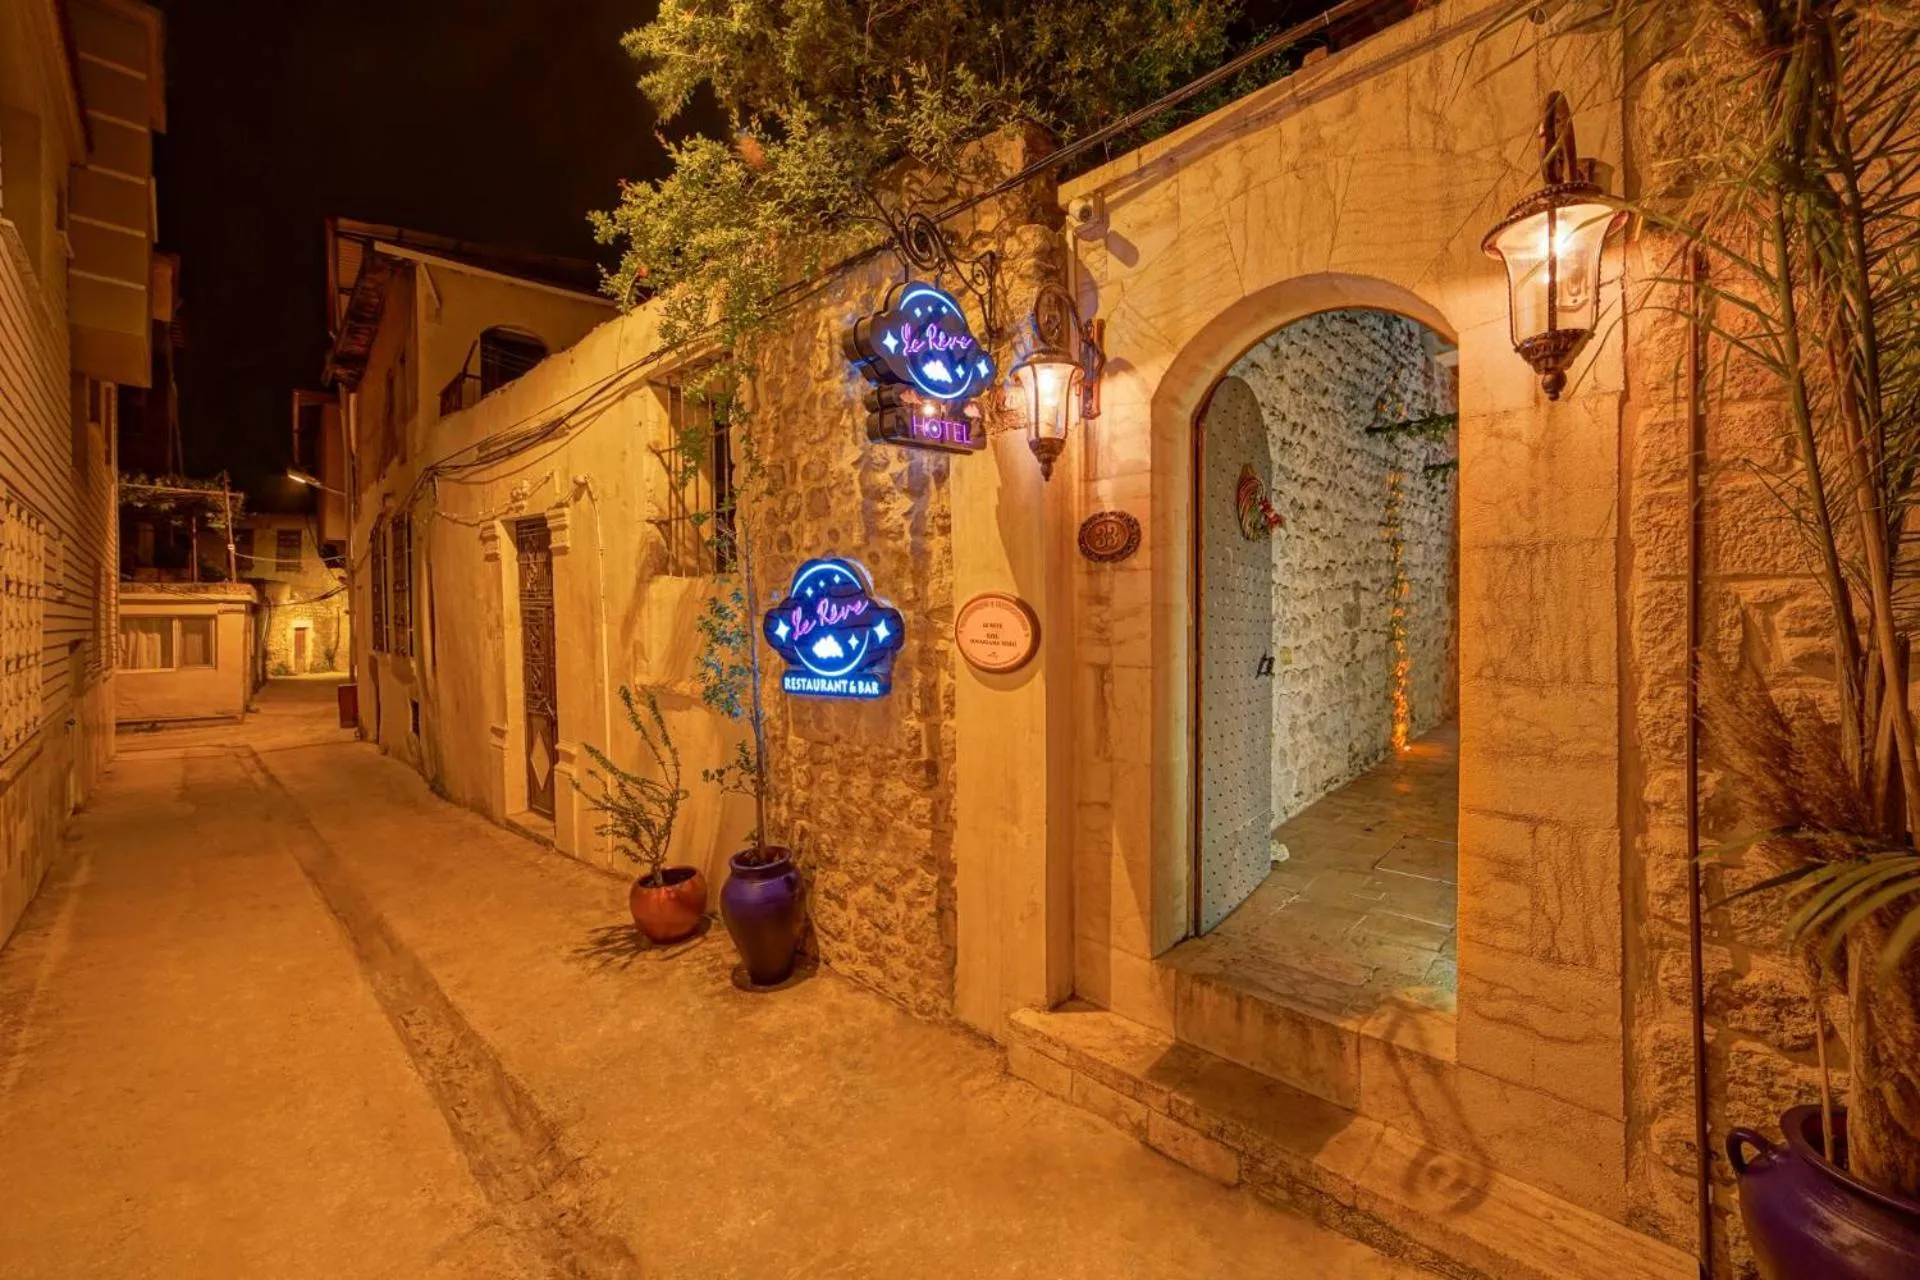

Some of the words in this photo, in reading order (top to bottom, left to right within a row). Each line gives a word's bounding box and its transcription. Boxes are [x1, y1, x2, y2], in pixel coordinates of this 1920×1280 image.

[912, 415, 973, 444] HOTEL
[1095, 523, 1118, 548] 33
[784, 677, 848, 693] RESTAURANT
[849, 680, 857, 693] &
[858, 680, 879, 694] BAR
